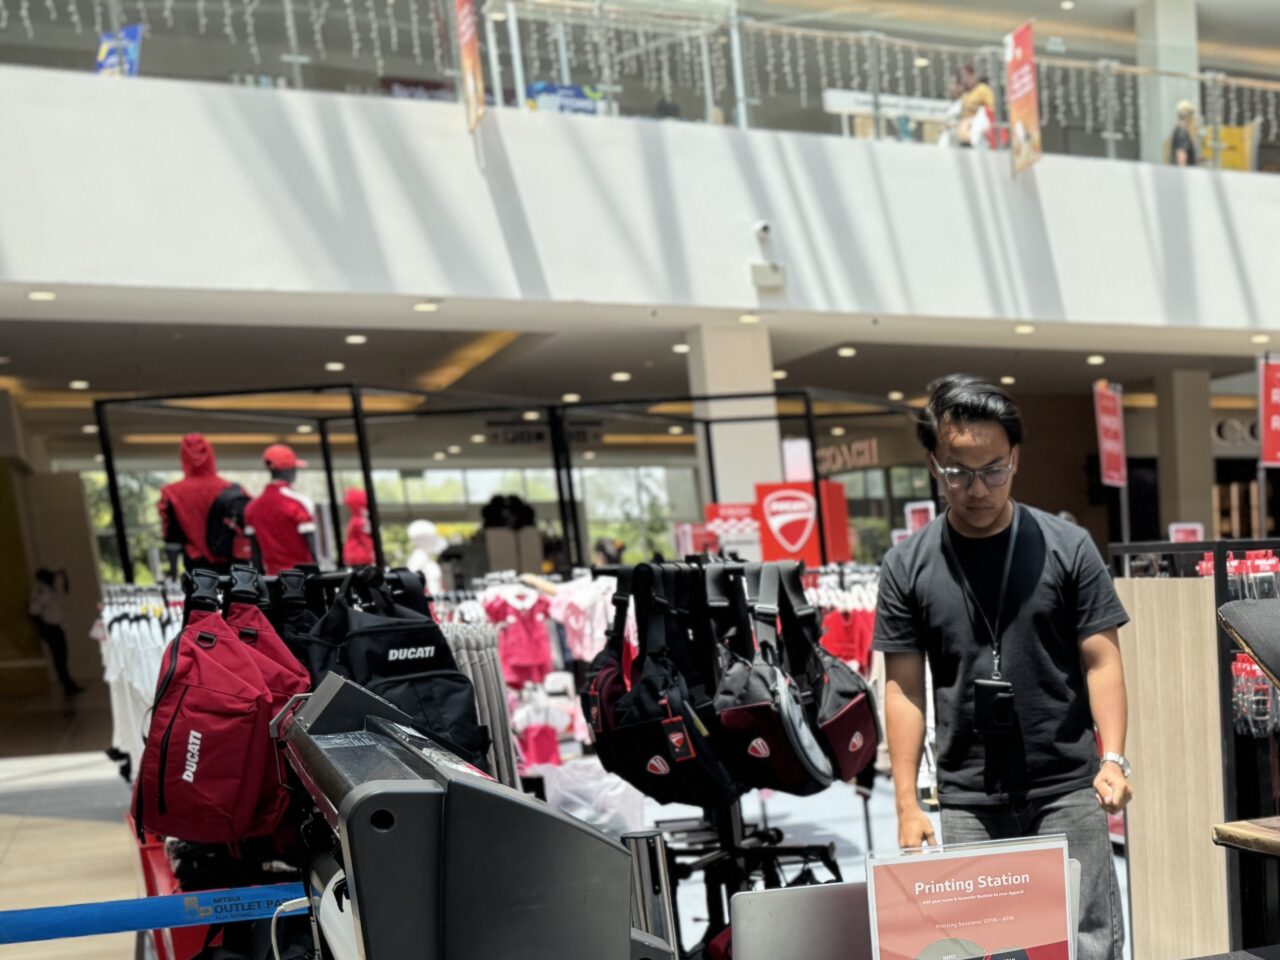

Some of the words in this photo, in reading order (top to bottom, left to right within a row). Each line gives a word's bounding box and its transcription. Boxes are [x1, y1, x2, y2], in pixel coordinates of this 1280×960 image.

[388, 646, 435, 662] DUCATI
[182, 729, 202, 783] DUCATI
[915, 878, 974, 896] Printing
[978, 872, 1030, 888] Station
[214, 902, 262, 914] OUTLET
[936, 922, 957, 930] Printing
